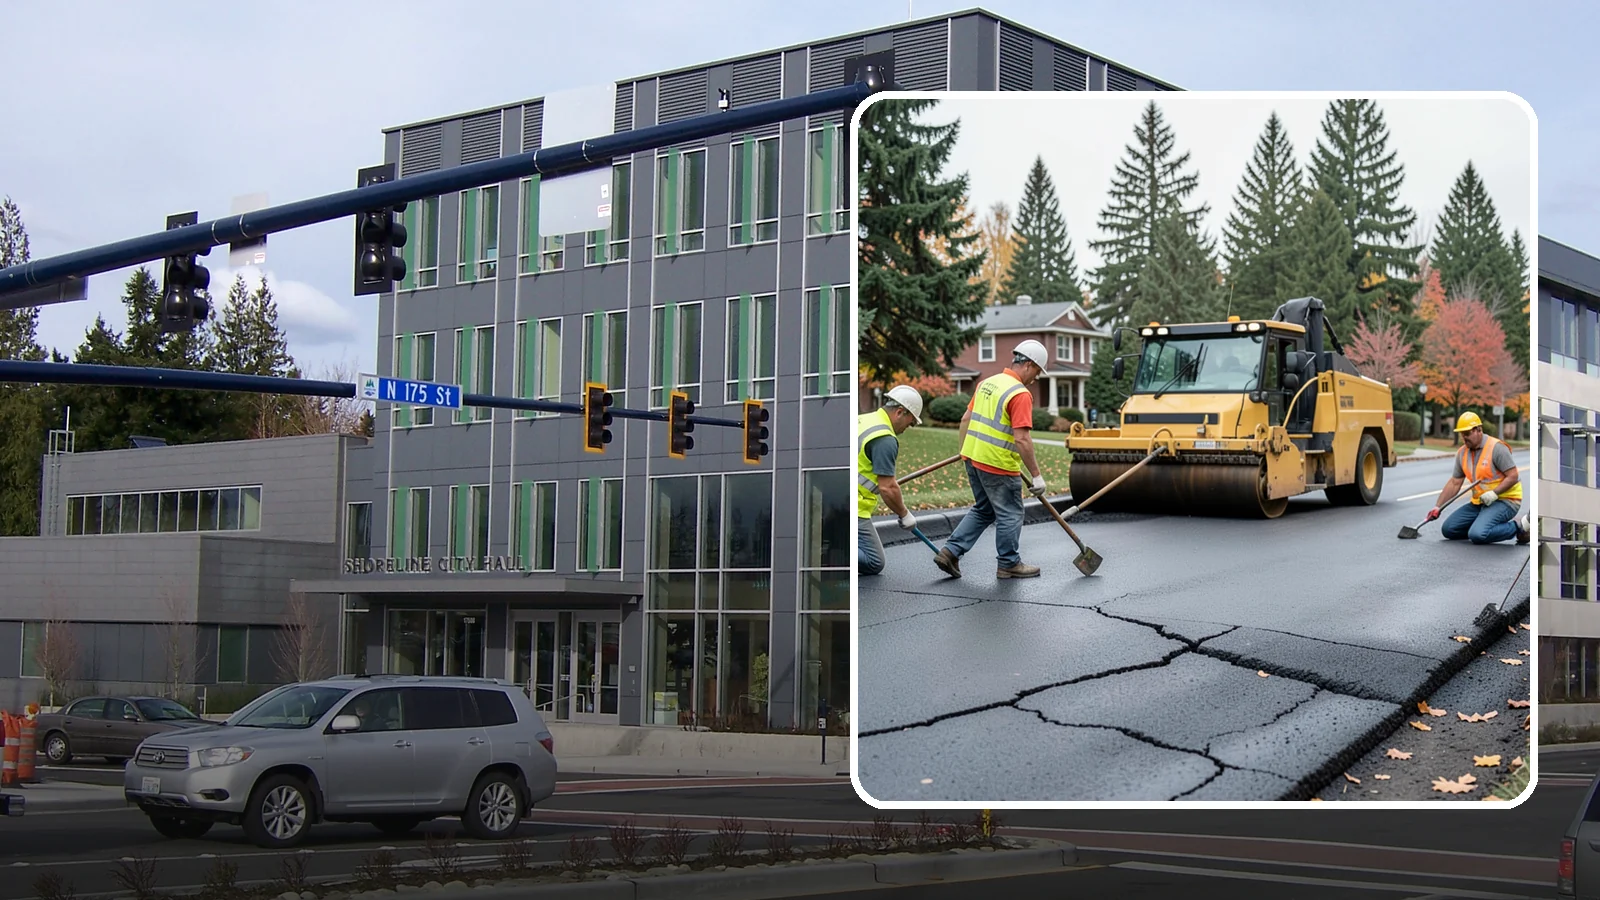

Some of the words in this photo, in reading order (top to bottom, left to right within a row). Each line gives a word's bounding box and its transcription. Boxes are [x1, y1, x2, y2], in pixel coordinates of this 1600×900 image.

[387, 380, 396, 400] N
[405, 382, 427, 403] 175
[436, 386, 451, 406] St
[344, 556, 432, 574] SHORELINE
[438, 556, 475, 573] CITY
[483, 555, 525, 572] HALL
